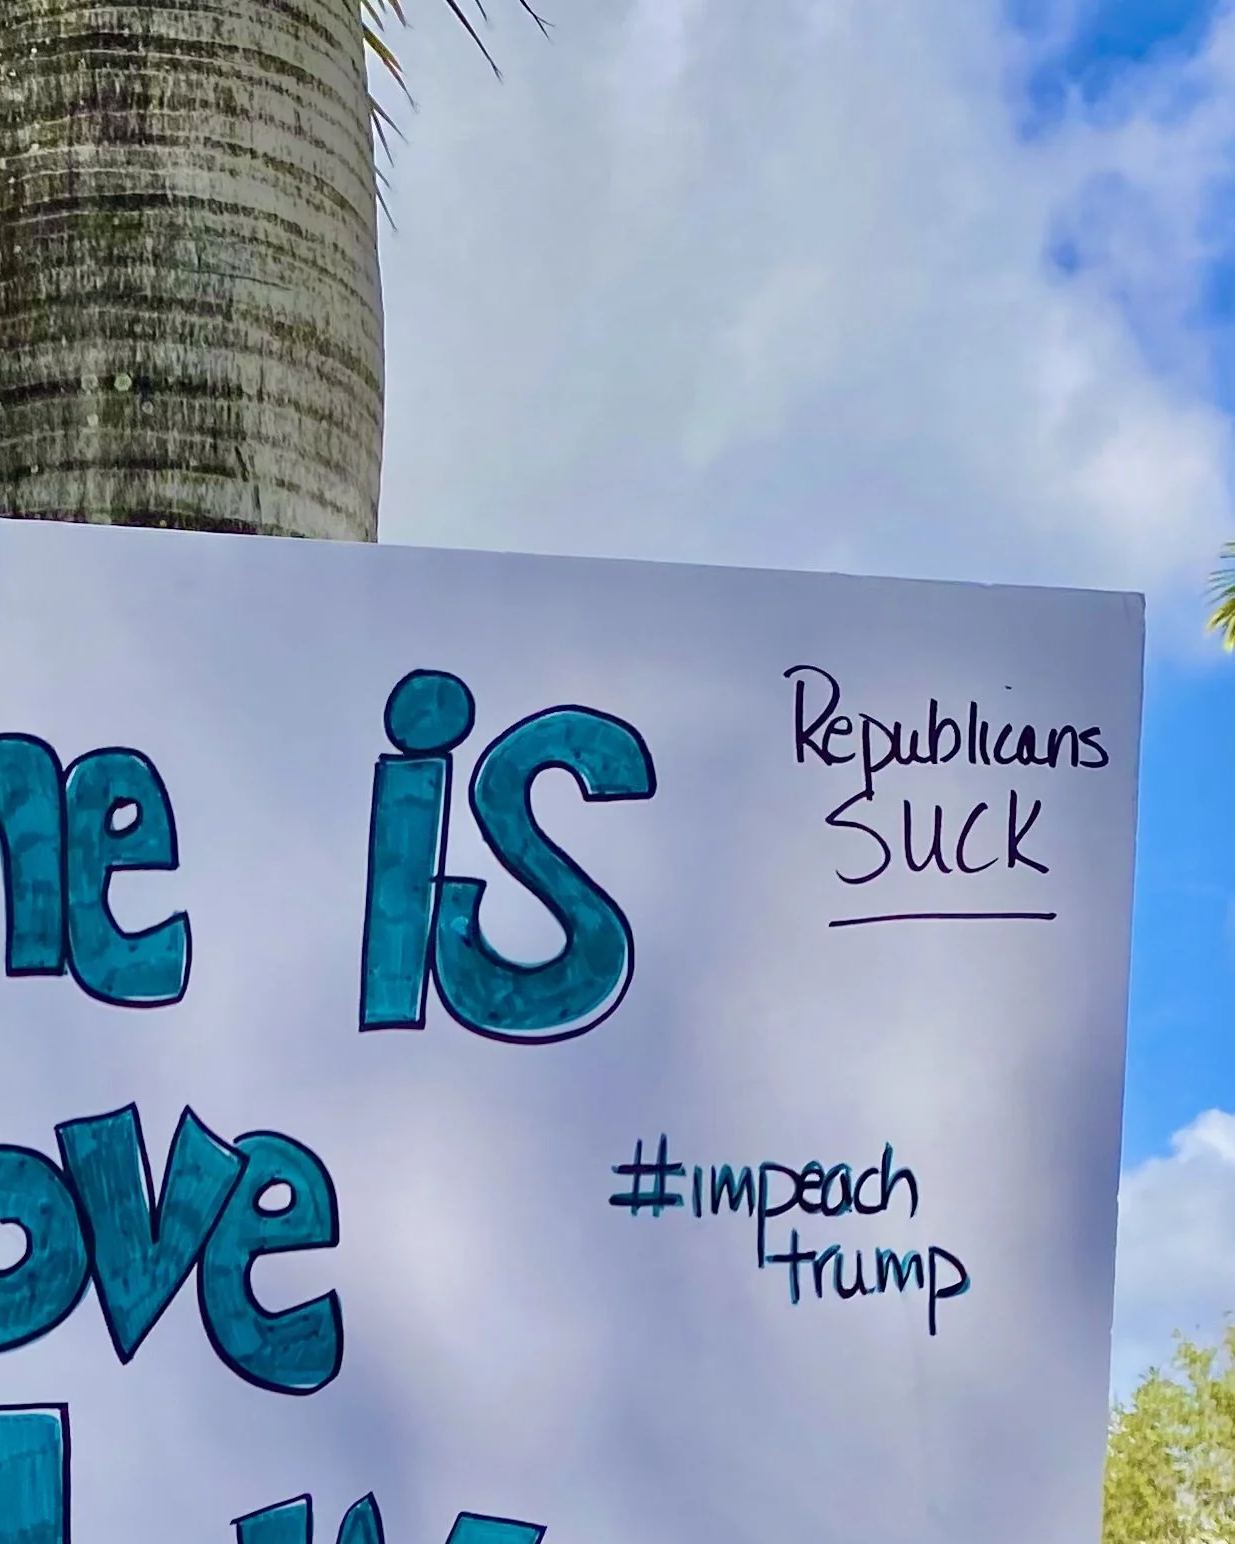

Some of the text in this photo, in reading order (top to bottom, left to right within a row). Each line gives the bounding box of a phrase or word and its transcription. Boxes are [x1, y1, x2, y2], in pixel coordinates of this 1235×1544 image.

[783, 666, 1109, 792] Republicans
[825, 794, 1050, 884] SUCK
[766, 1227, 970, 1336] trump
